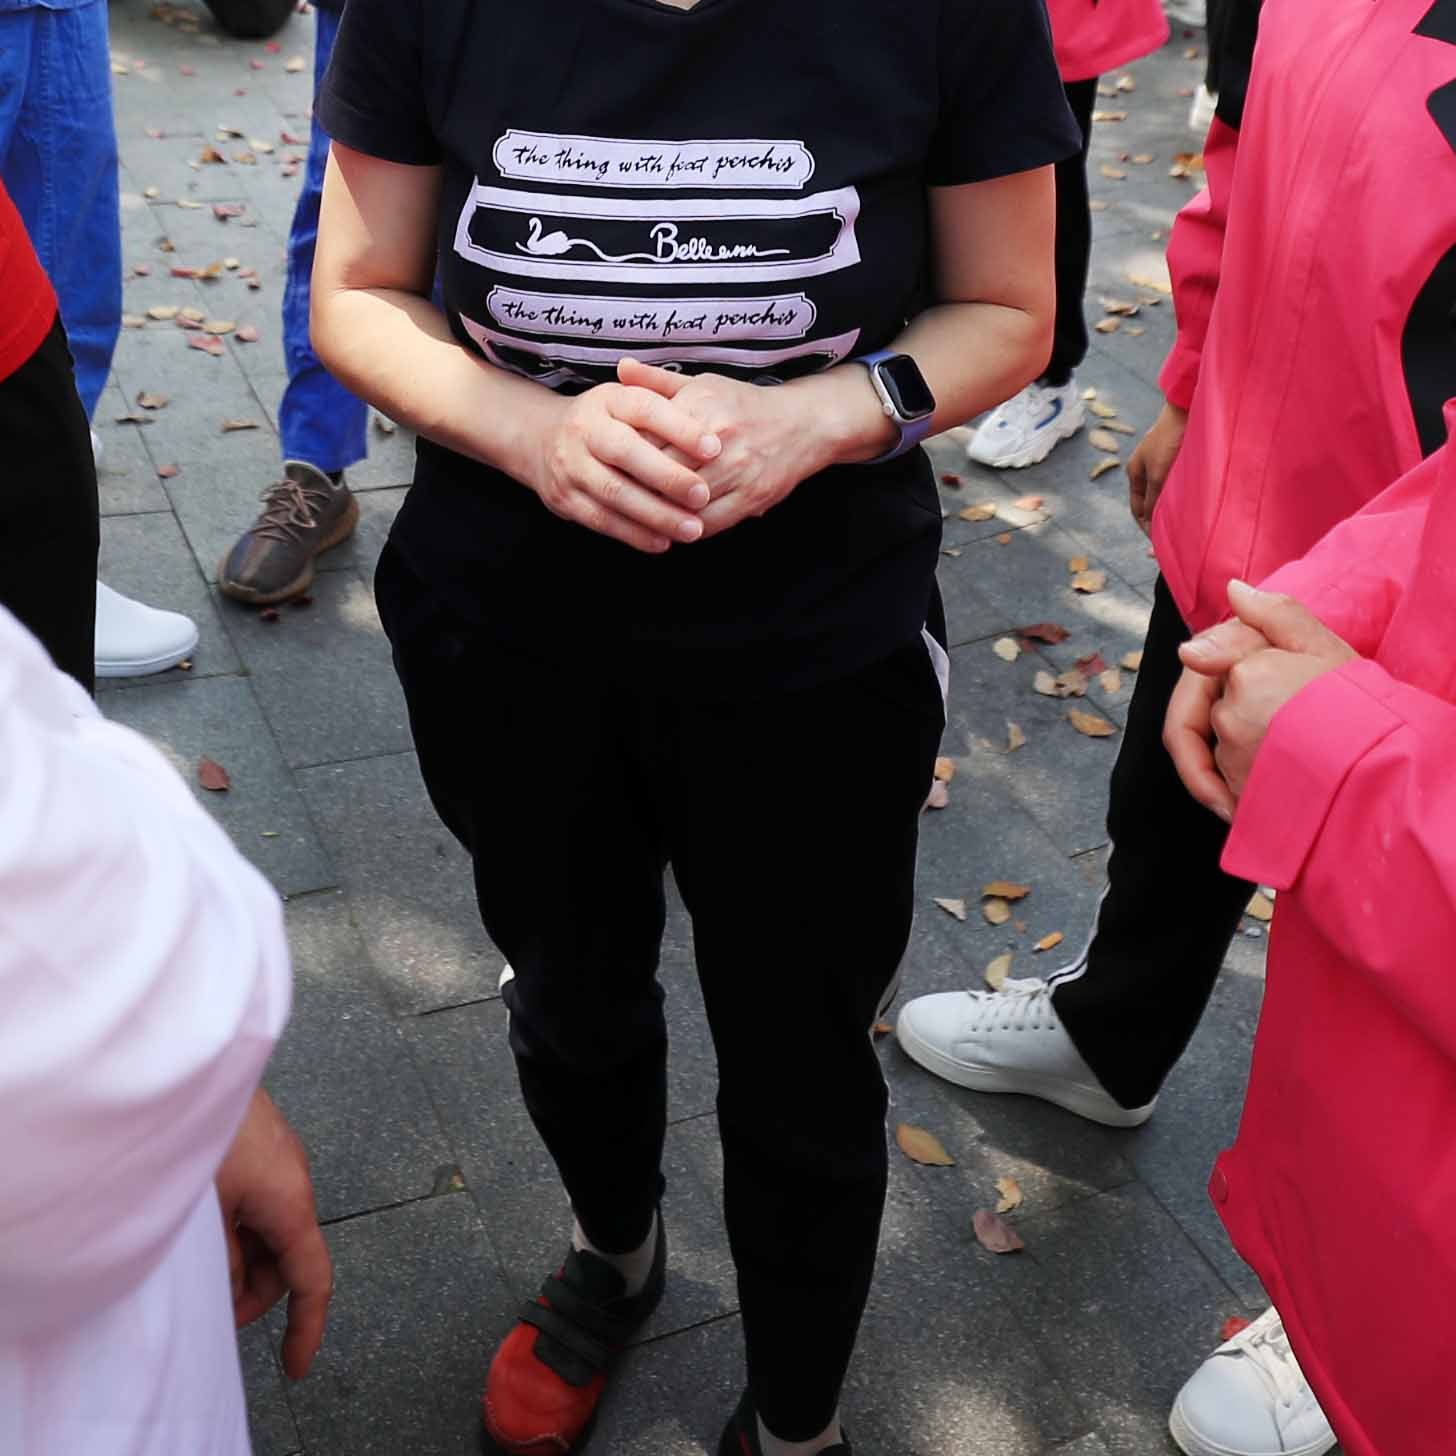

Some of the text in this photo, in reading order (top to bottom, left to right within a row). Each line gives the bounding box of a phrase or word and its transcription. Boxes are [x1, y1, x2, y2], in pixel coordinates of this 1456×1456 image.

[512, 144, 549, 164] the
[554, 147, 610, 180] thing
[619, 154, 664, 173] with
[502, 301, 539, 321] the
[542, 305, 604, 334] thing
[613, 312, 658, 331] with
